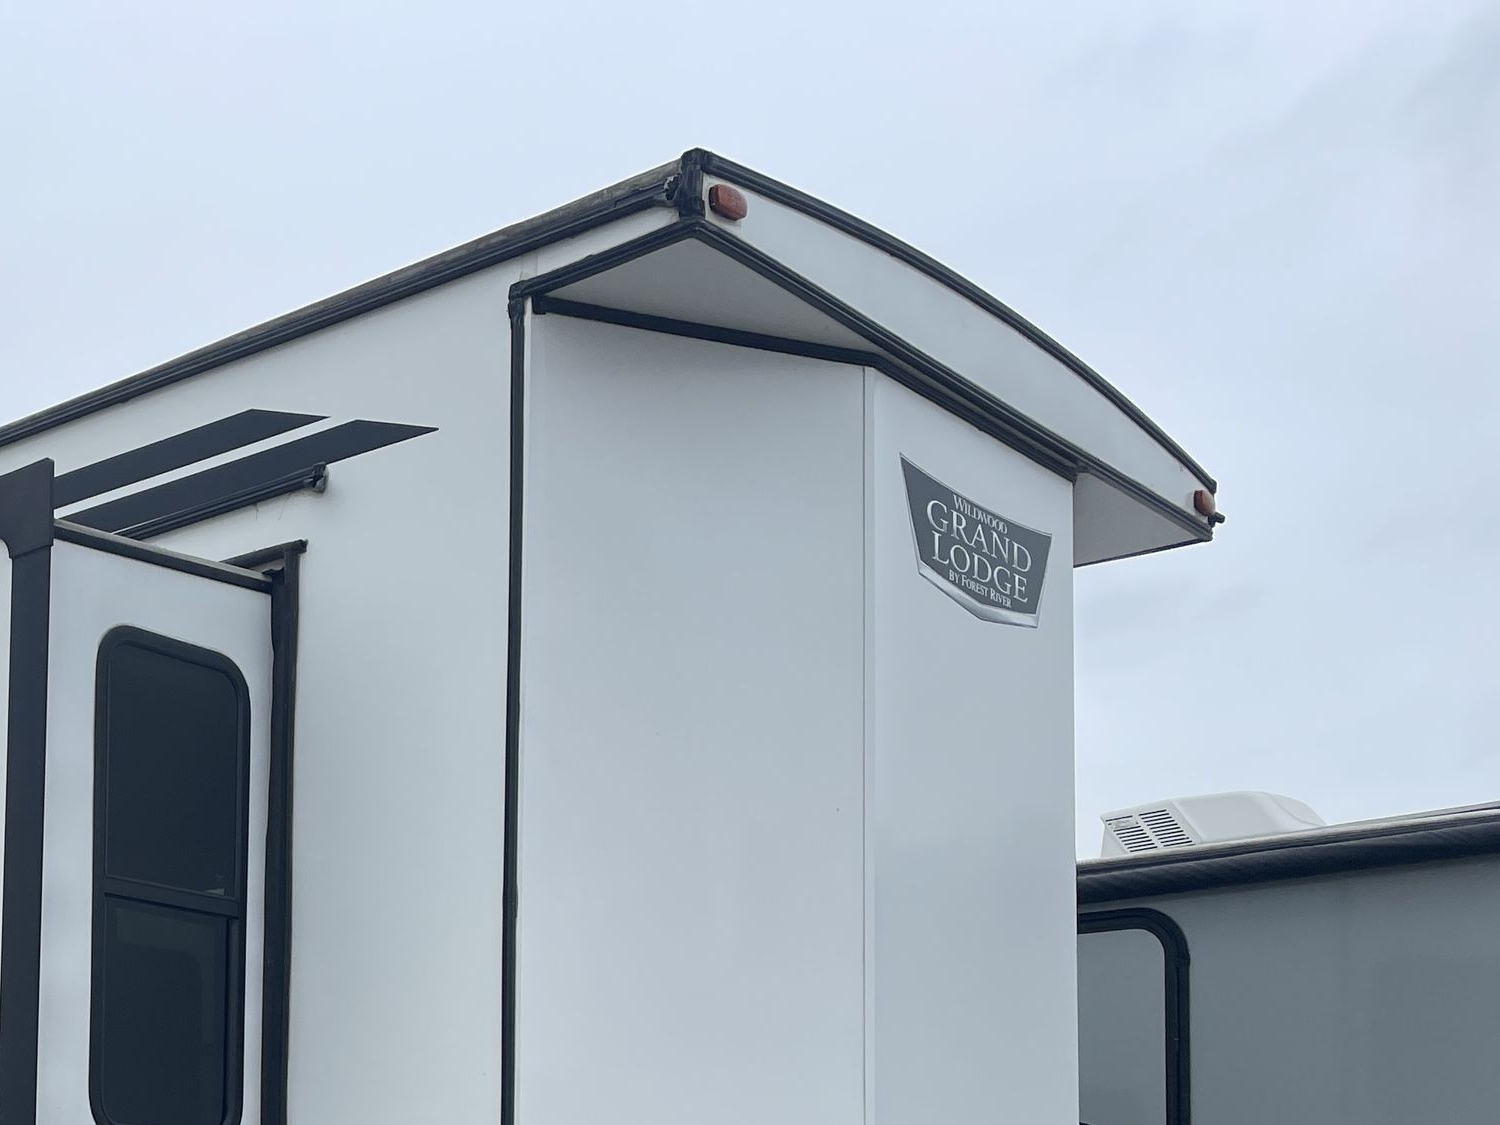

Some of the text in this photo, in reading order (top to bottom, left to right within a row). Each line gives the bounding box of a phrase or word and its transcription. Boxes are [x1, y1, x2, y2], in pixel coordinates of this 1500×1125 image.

[927, 500, 1032, 572] GRAND
[953, 494, 1008, 534] WILDWOOD
[932, 530, 1028, 603] LODGE
[949, 569, 1012, 608] BY FOREST RIVER
